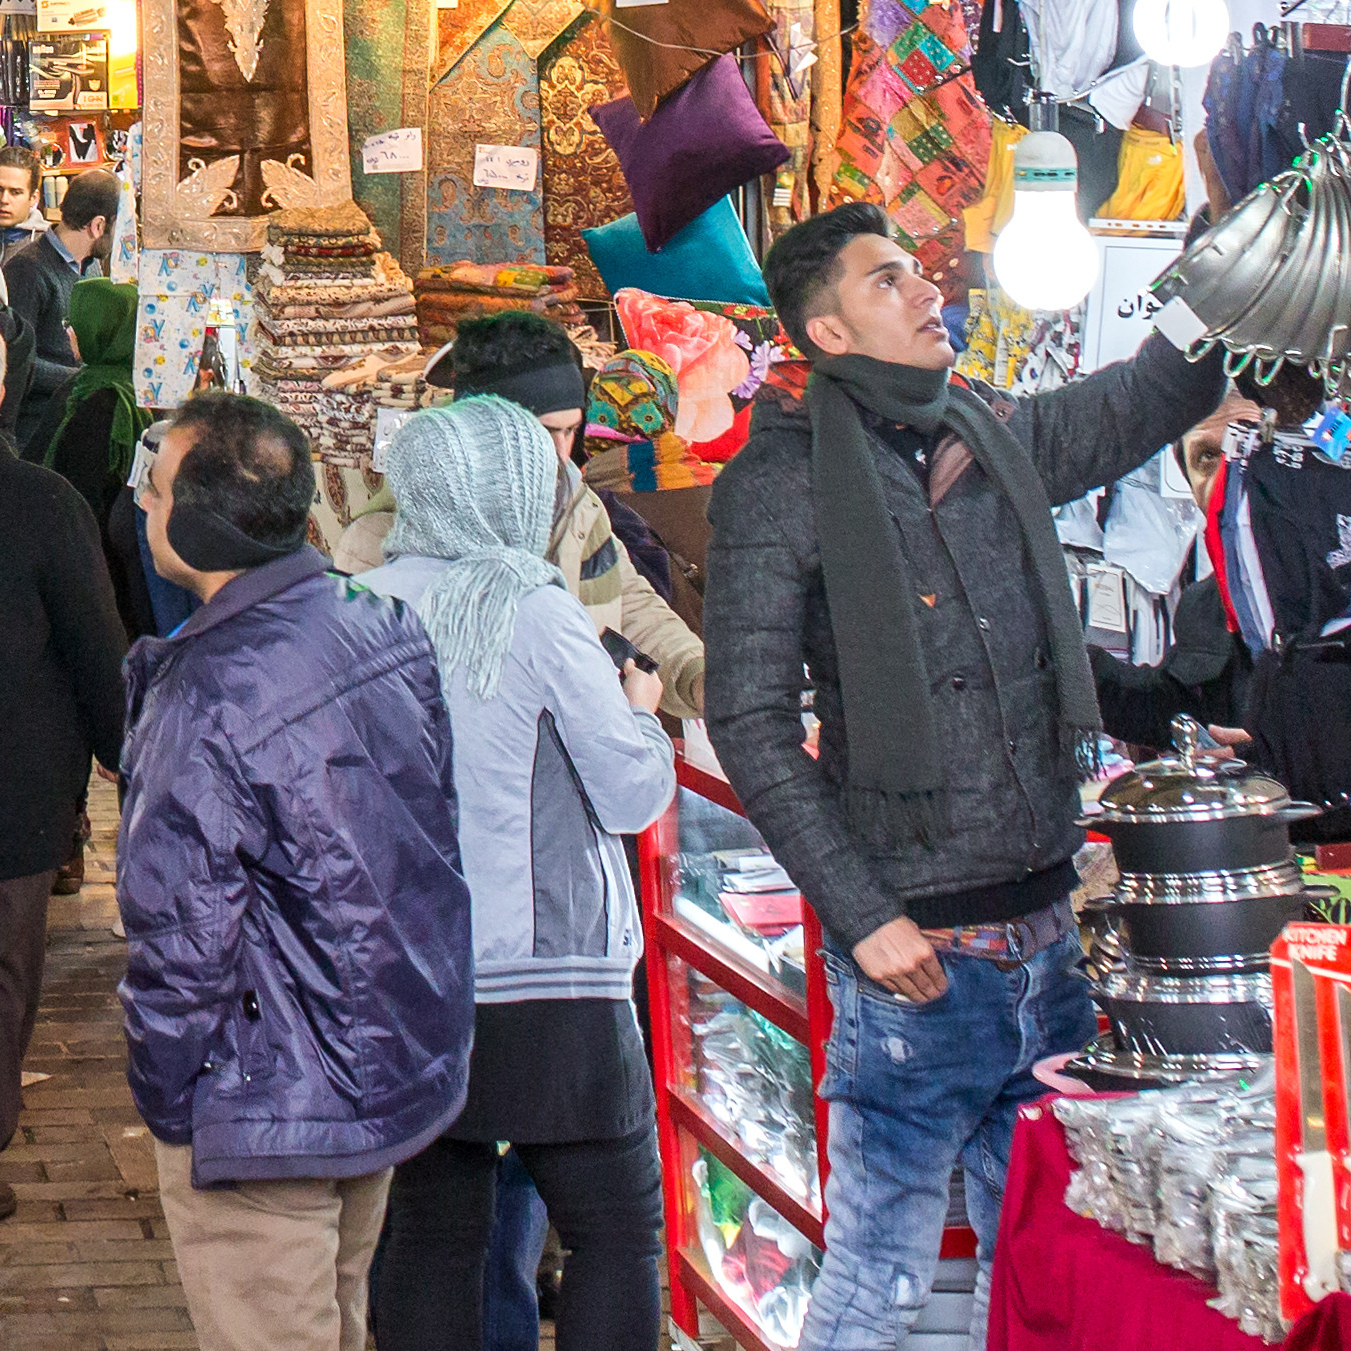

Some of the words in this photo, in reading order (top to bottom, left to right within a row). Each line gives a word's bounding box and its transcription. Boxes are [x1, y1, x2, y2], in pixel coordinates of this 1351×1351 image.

[1118, 294, 1161, 320] وان
[1282, 928, 1347, 945] KITCHEN
[1288, 944, 1337, 961] KNIFE
